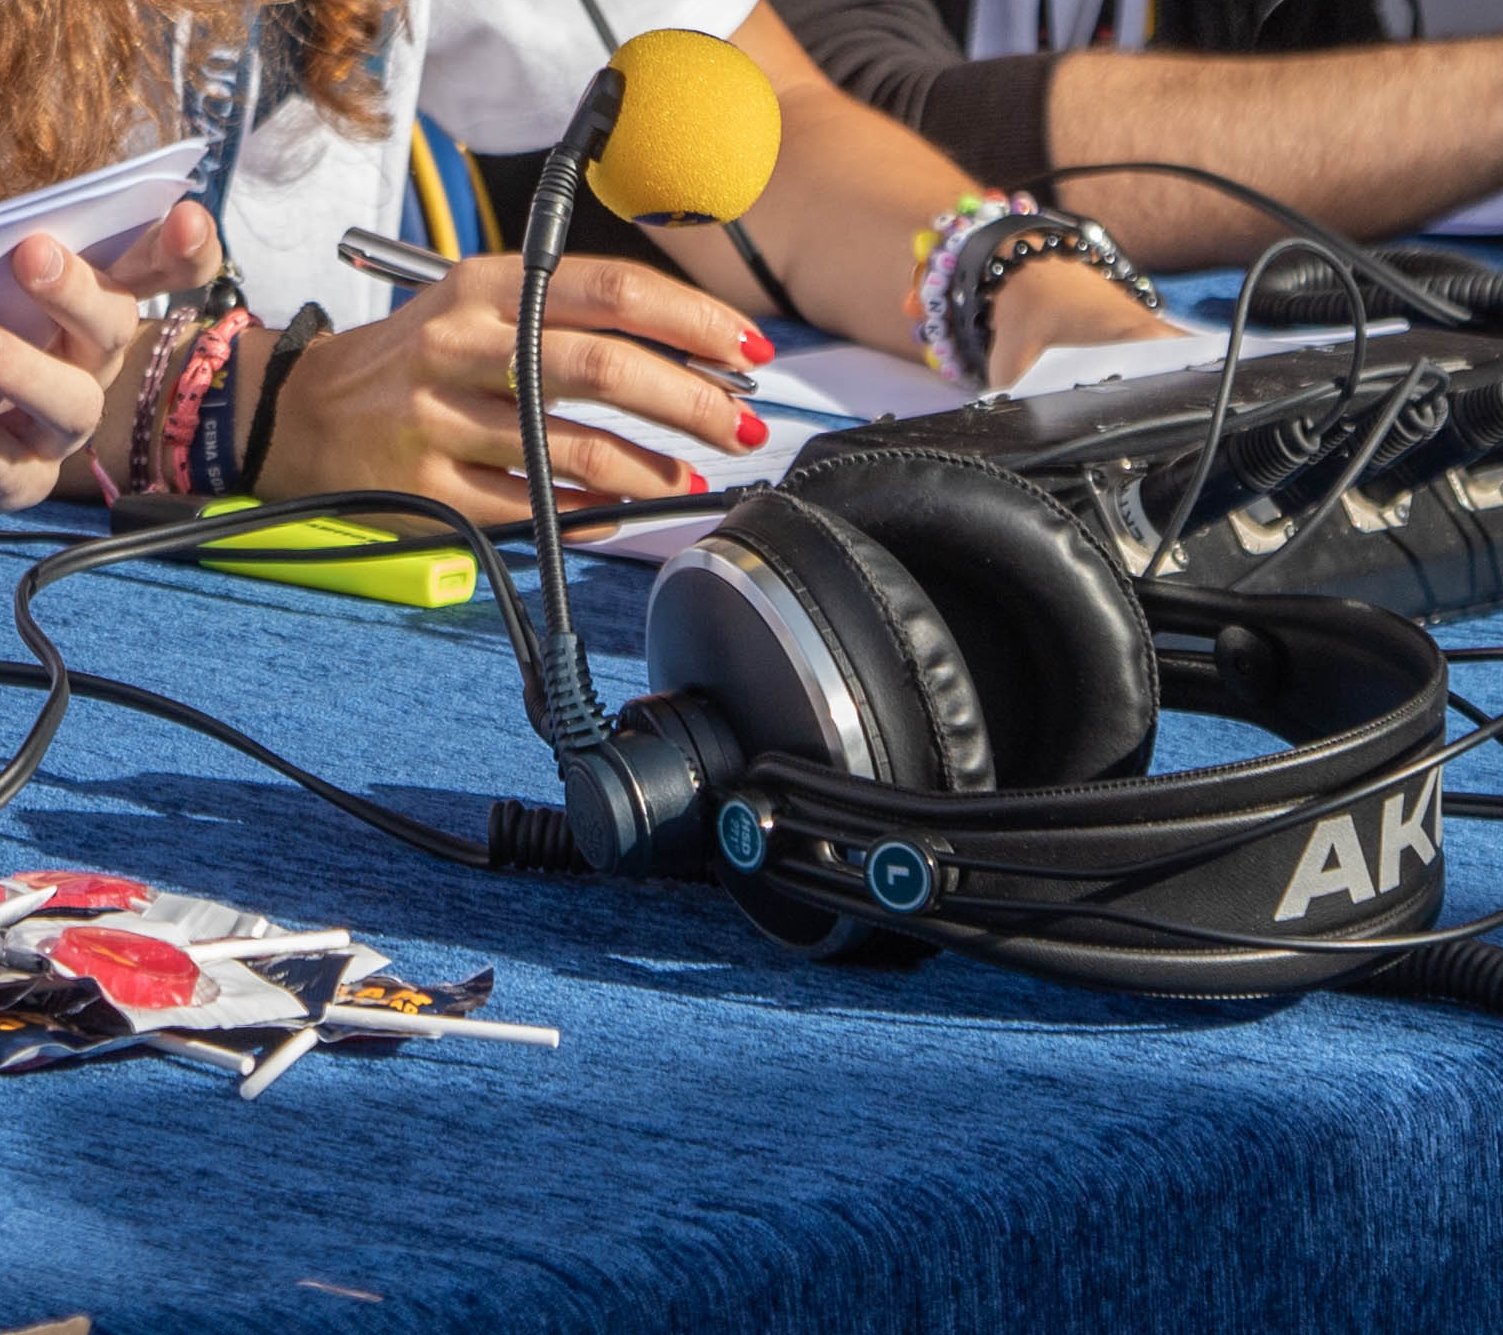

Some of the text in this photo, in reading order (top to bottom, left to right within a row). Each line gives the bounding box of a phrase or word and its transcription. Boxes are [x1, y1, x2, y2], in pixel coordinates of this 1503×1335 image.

[203, 419, 217, 463] CENA
[1274, 765, 1443, 922] AK
[887, 865, 910, 886] L
